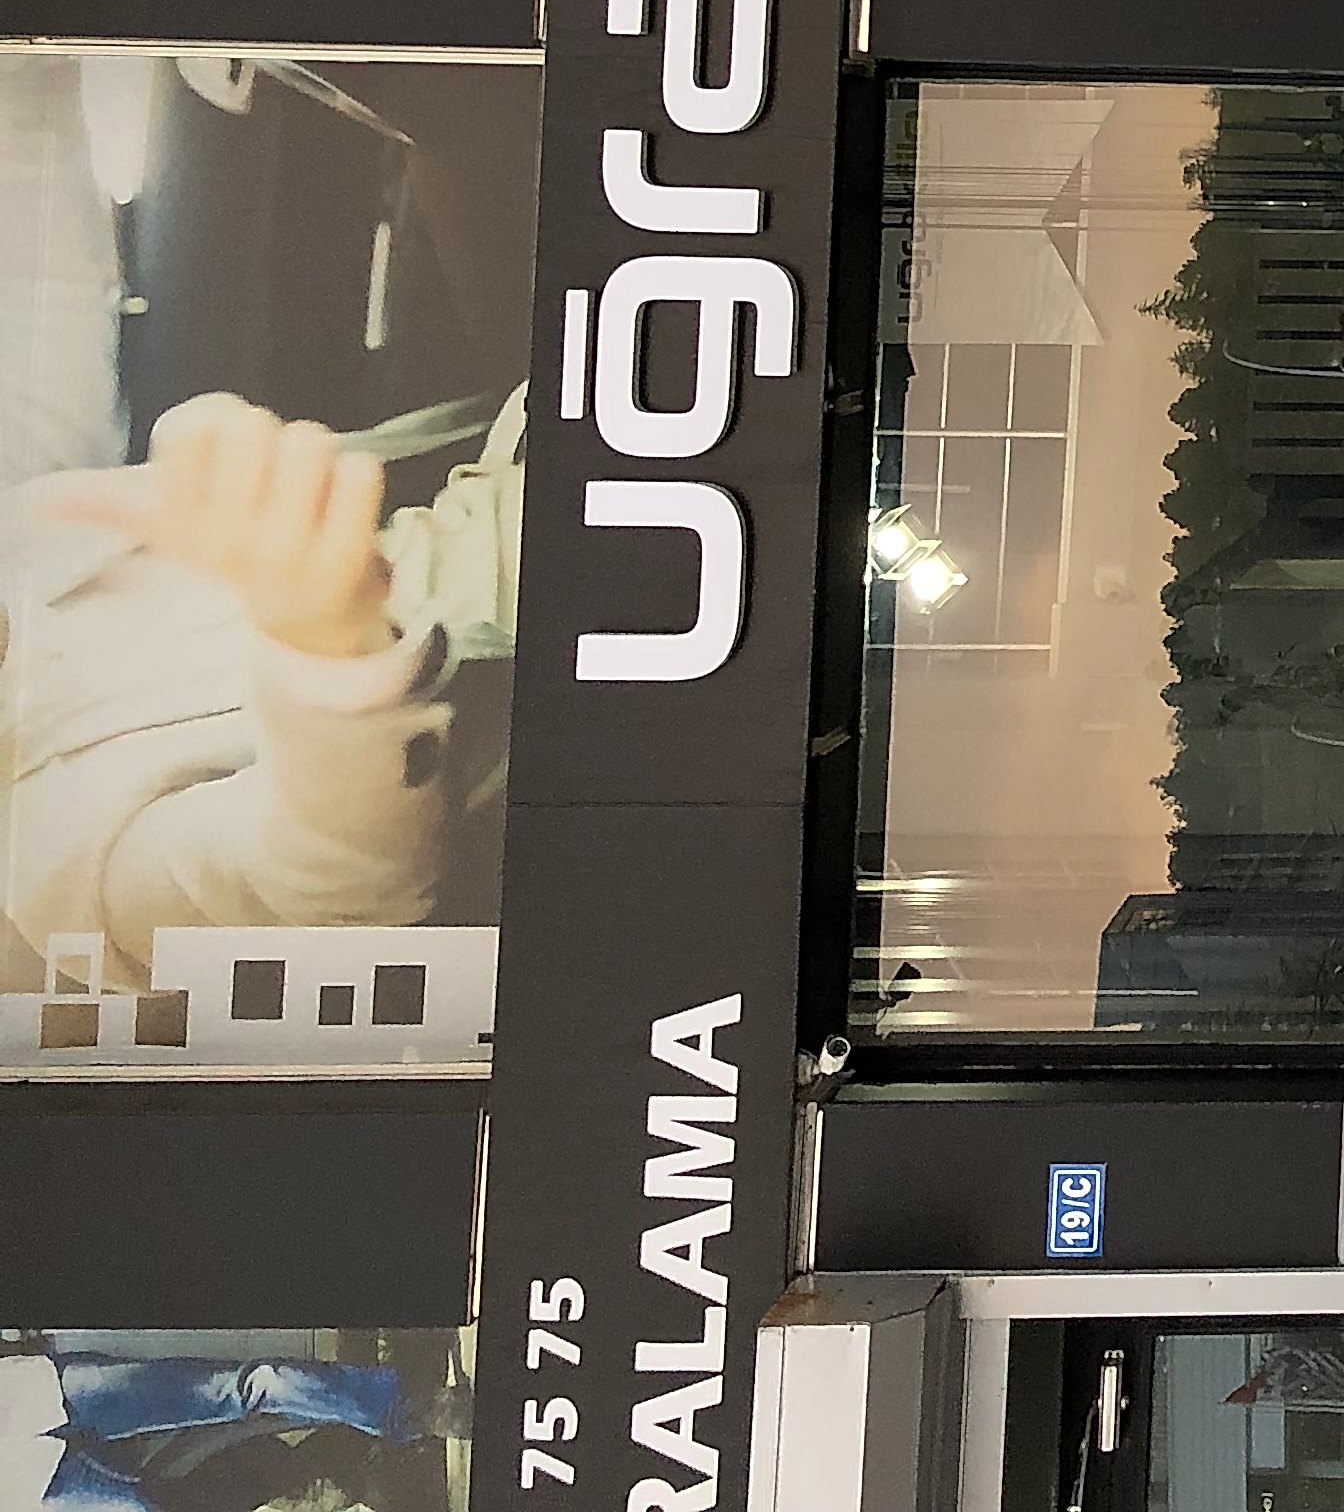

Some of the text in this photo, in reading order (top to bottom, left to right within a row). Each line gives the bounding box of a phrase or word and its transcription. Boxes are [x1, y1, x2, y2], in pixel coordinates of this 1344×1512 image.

[1059, 1176, 1092, 1246] 19/C
[520, 1277, 585, 1489] 75 75
